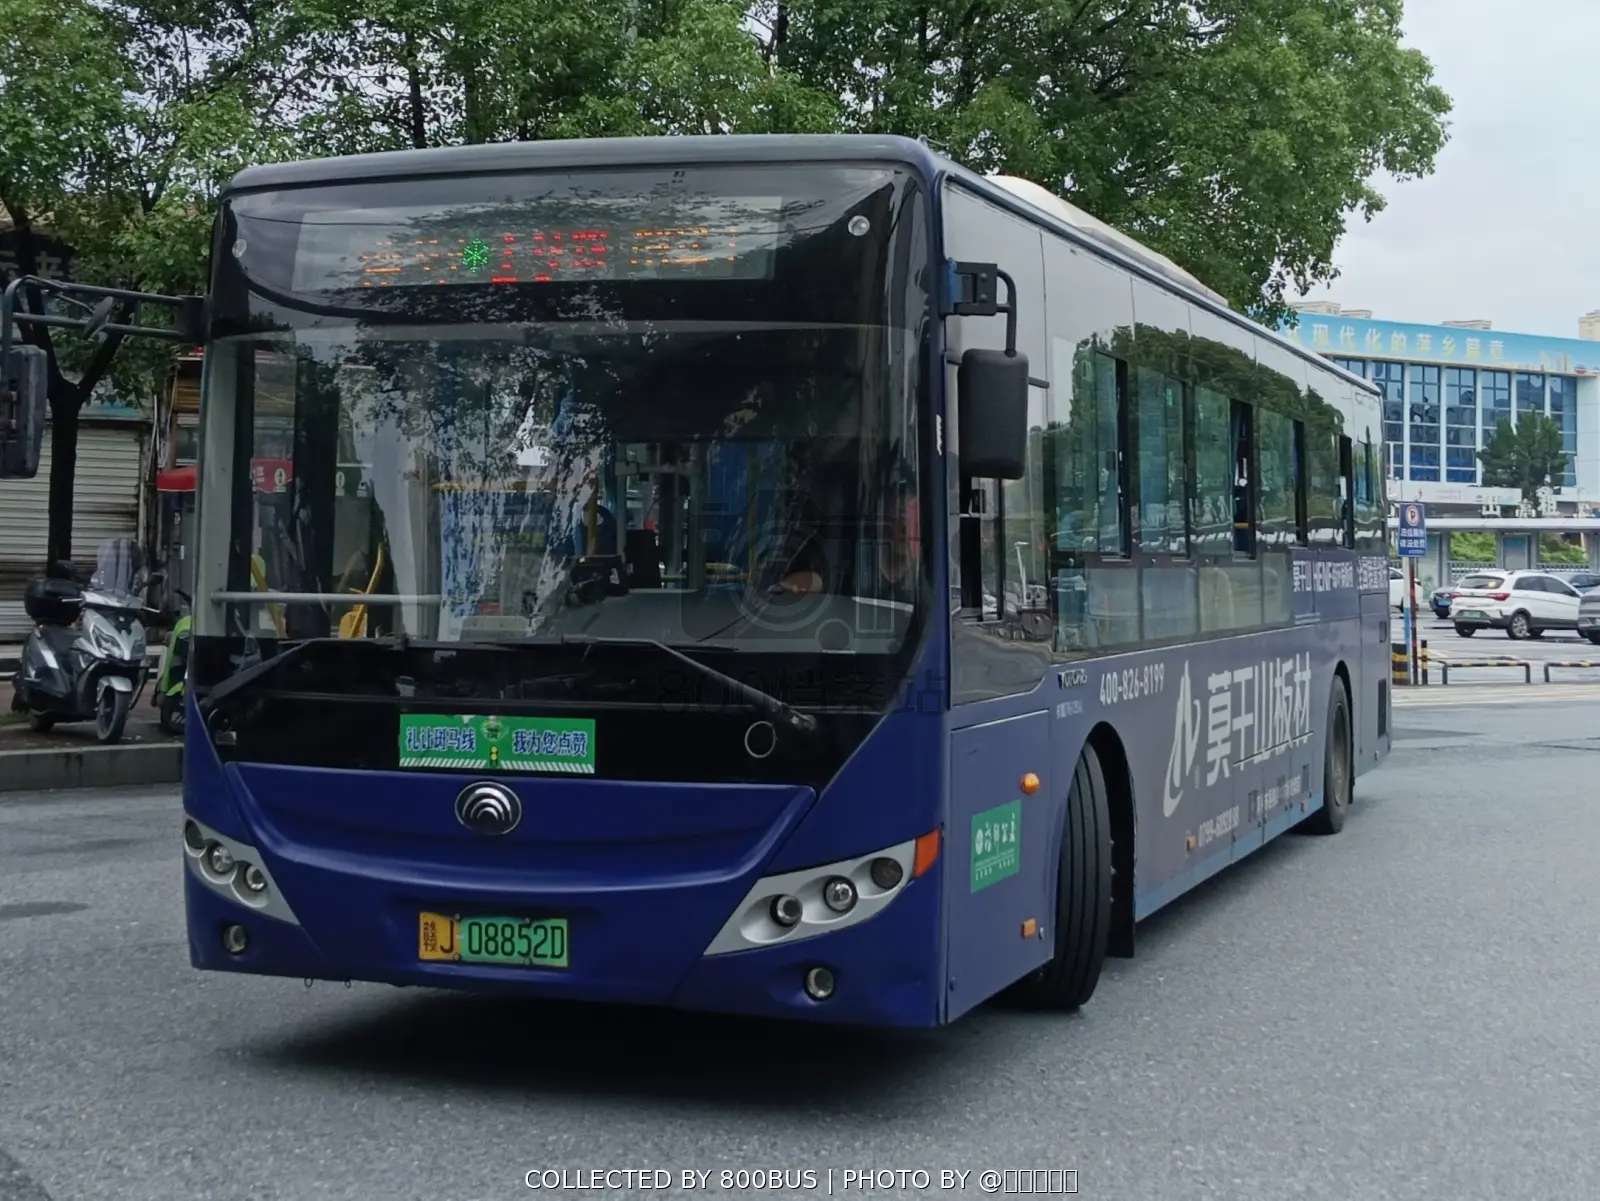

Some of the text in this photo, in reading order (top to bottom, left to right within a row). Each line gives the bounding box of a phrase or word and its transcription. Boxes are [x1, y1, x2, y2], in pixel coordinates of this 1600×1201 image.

[1100, 662, 1165, 706] 400-826-8199
[1206, 651, 1313, 787] 莫干山板材
[406, 726, 476, 753] 礼让斑马线
[512, 729, 588, 757] 我为您点赞
[467, 921, 565, 959] 08852D
